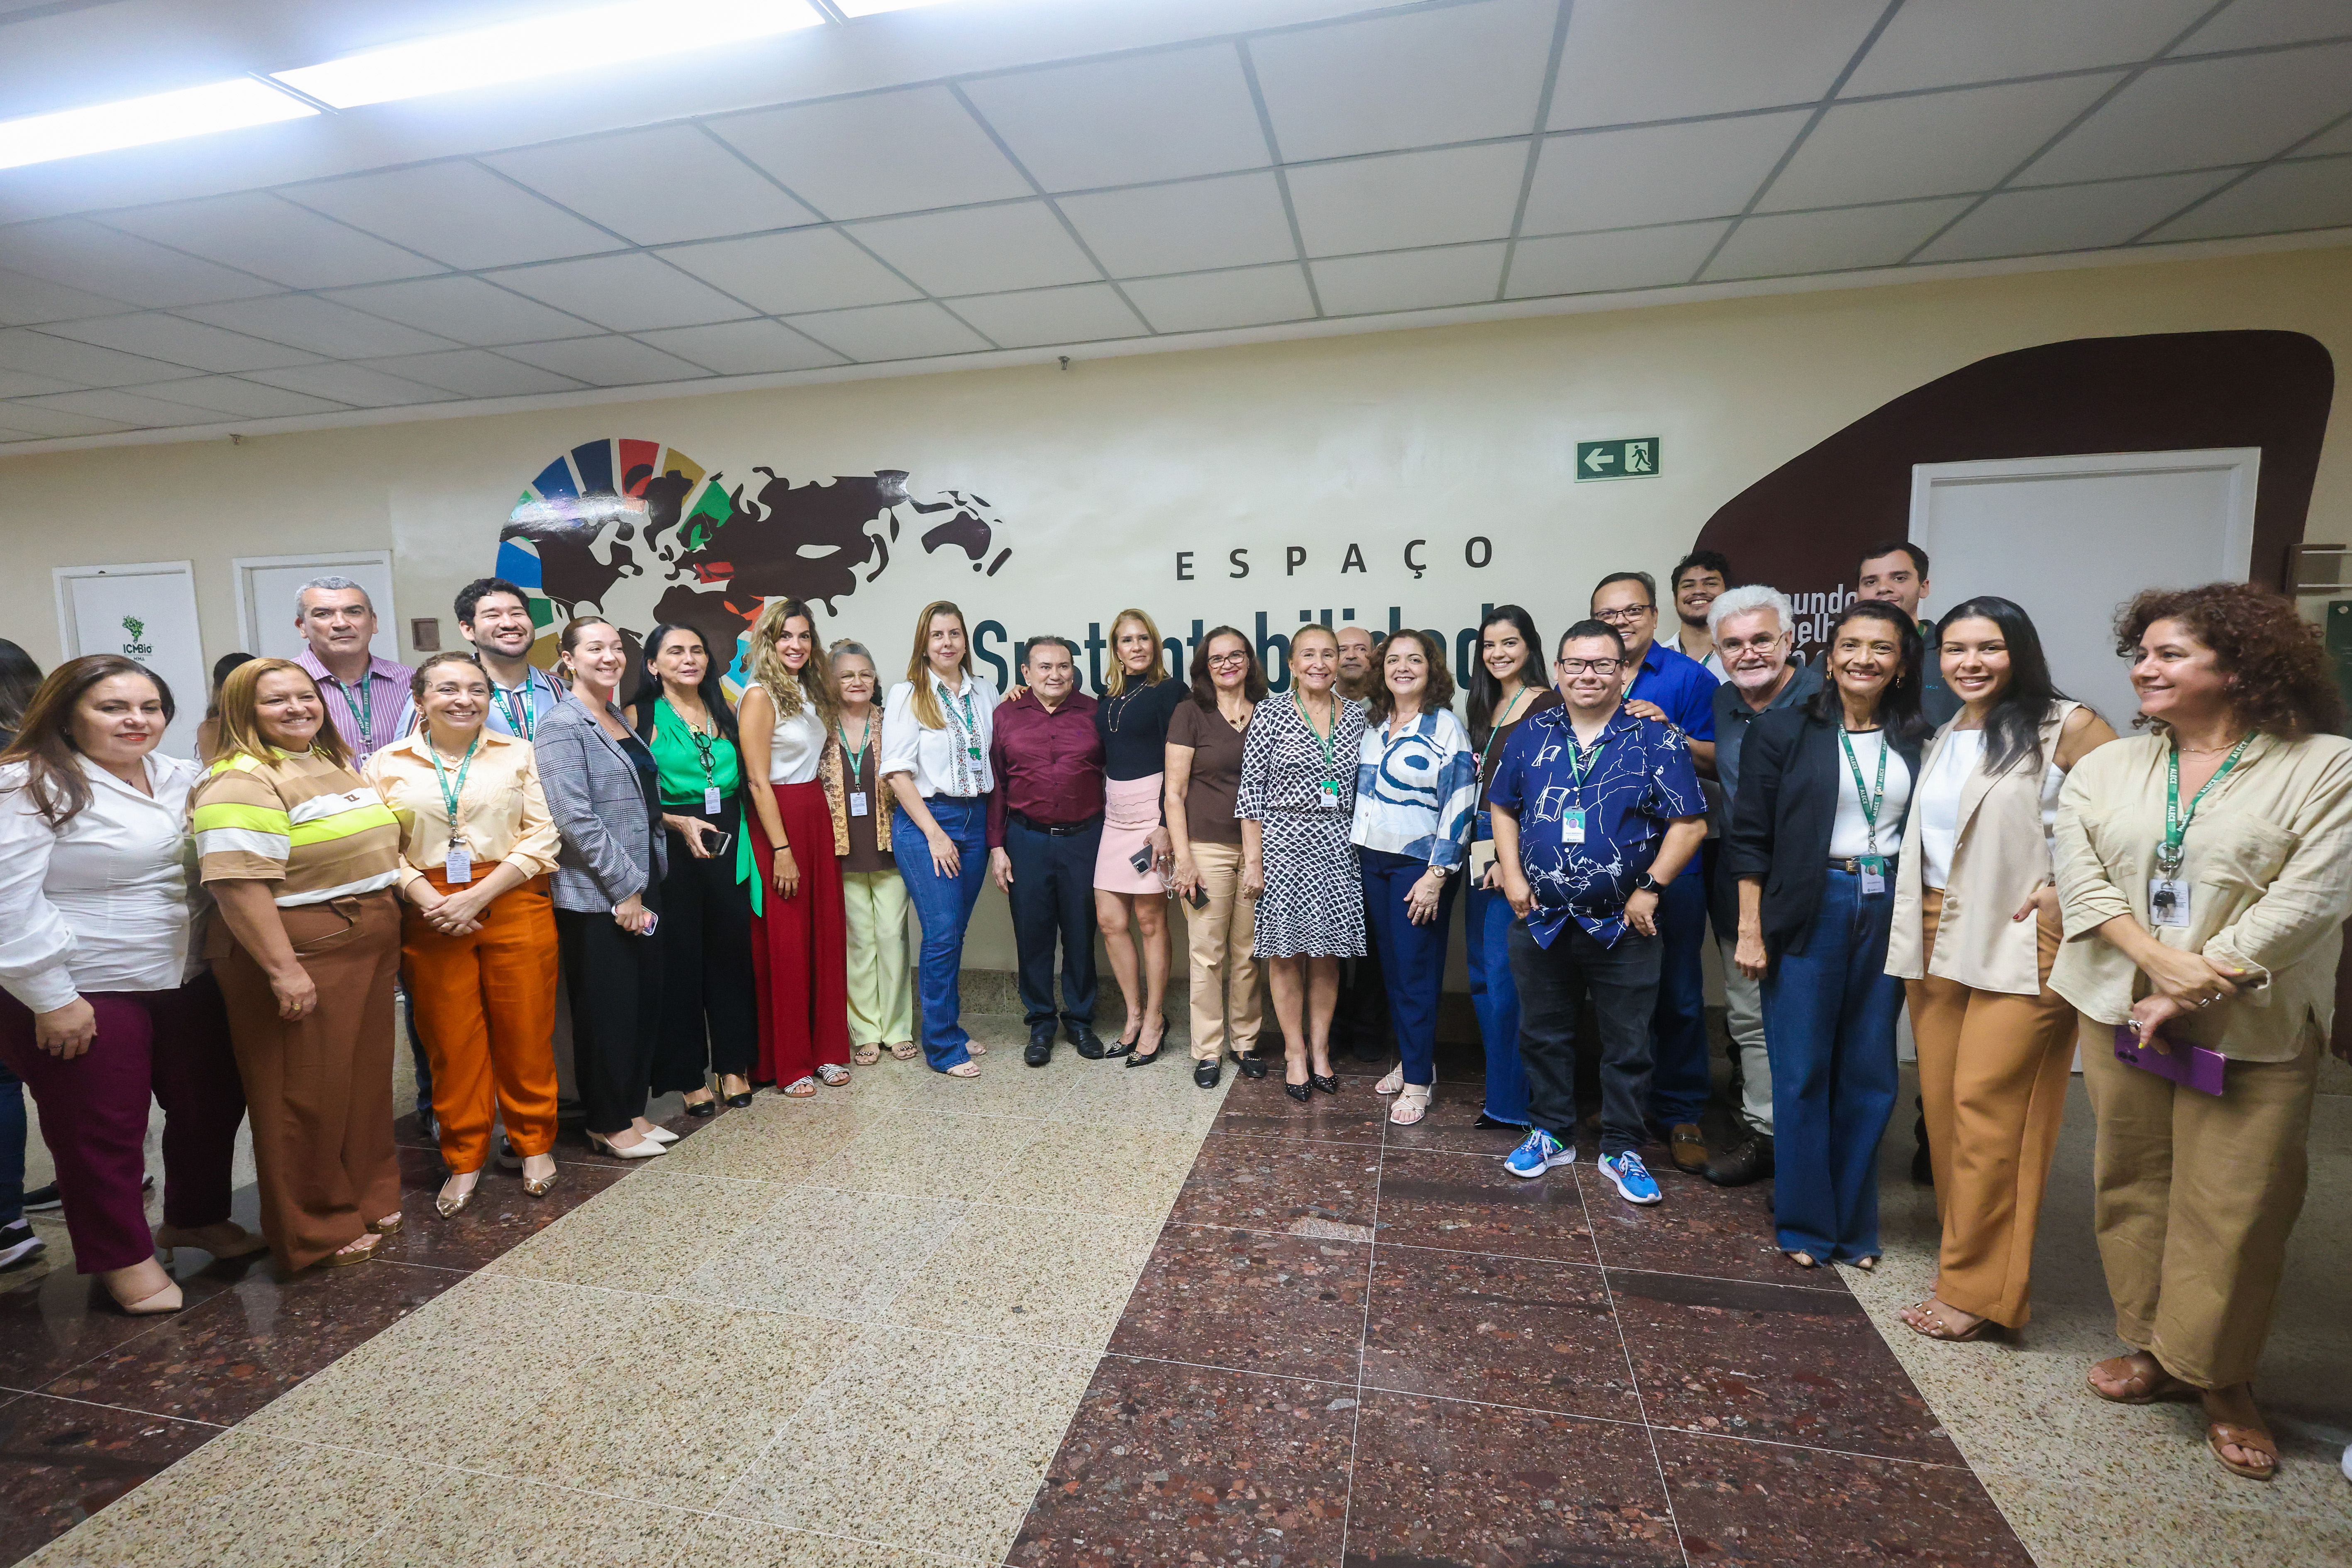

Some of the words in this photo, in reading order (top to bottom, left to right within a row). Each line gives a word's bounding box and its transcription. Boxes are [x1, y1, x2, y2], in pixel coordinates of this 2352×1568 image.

[1176, 536, 1492, 580] ESPAÇO
[123, 644, 152, 654] ICMBio
[343, 688, 352, 700] ALECE
[499, 700, 509, 713] ALECE
[513, 727, 522, 738] LECE
[2231, 740, 2248, 759] ALECE
[1849, 755, 1858, 770] ALECE
[2200, 778, 2219, 793] ALECE
[1859, 789, 1868, 805] ALECE
[2168, 805, 2176, 822] ALECE
